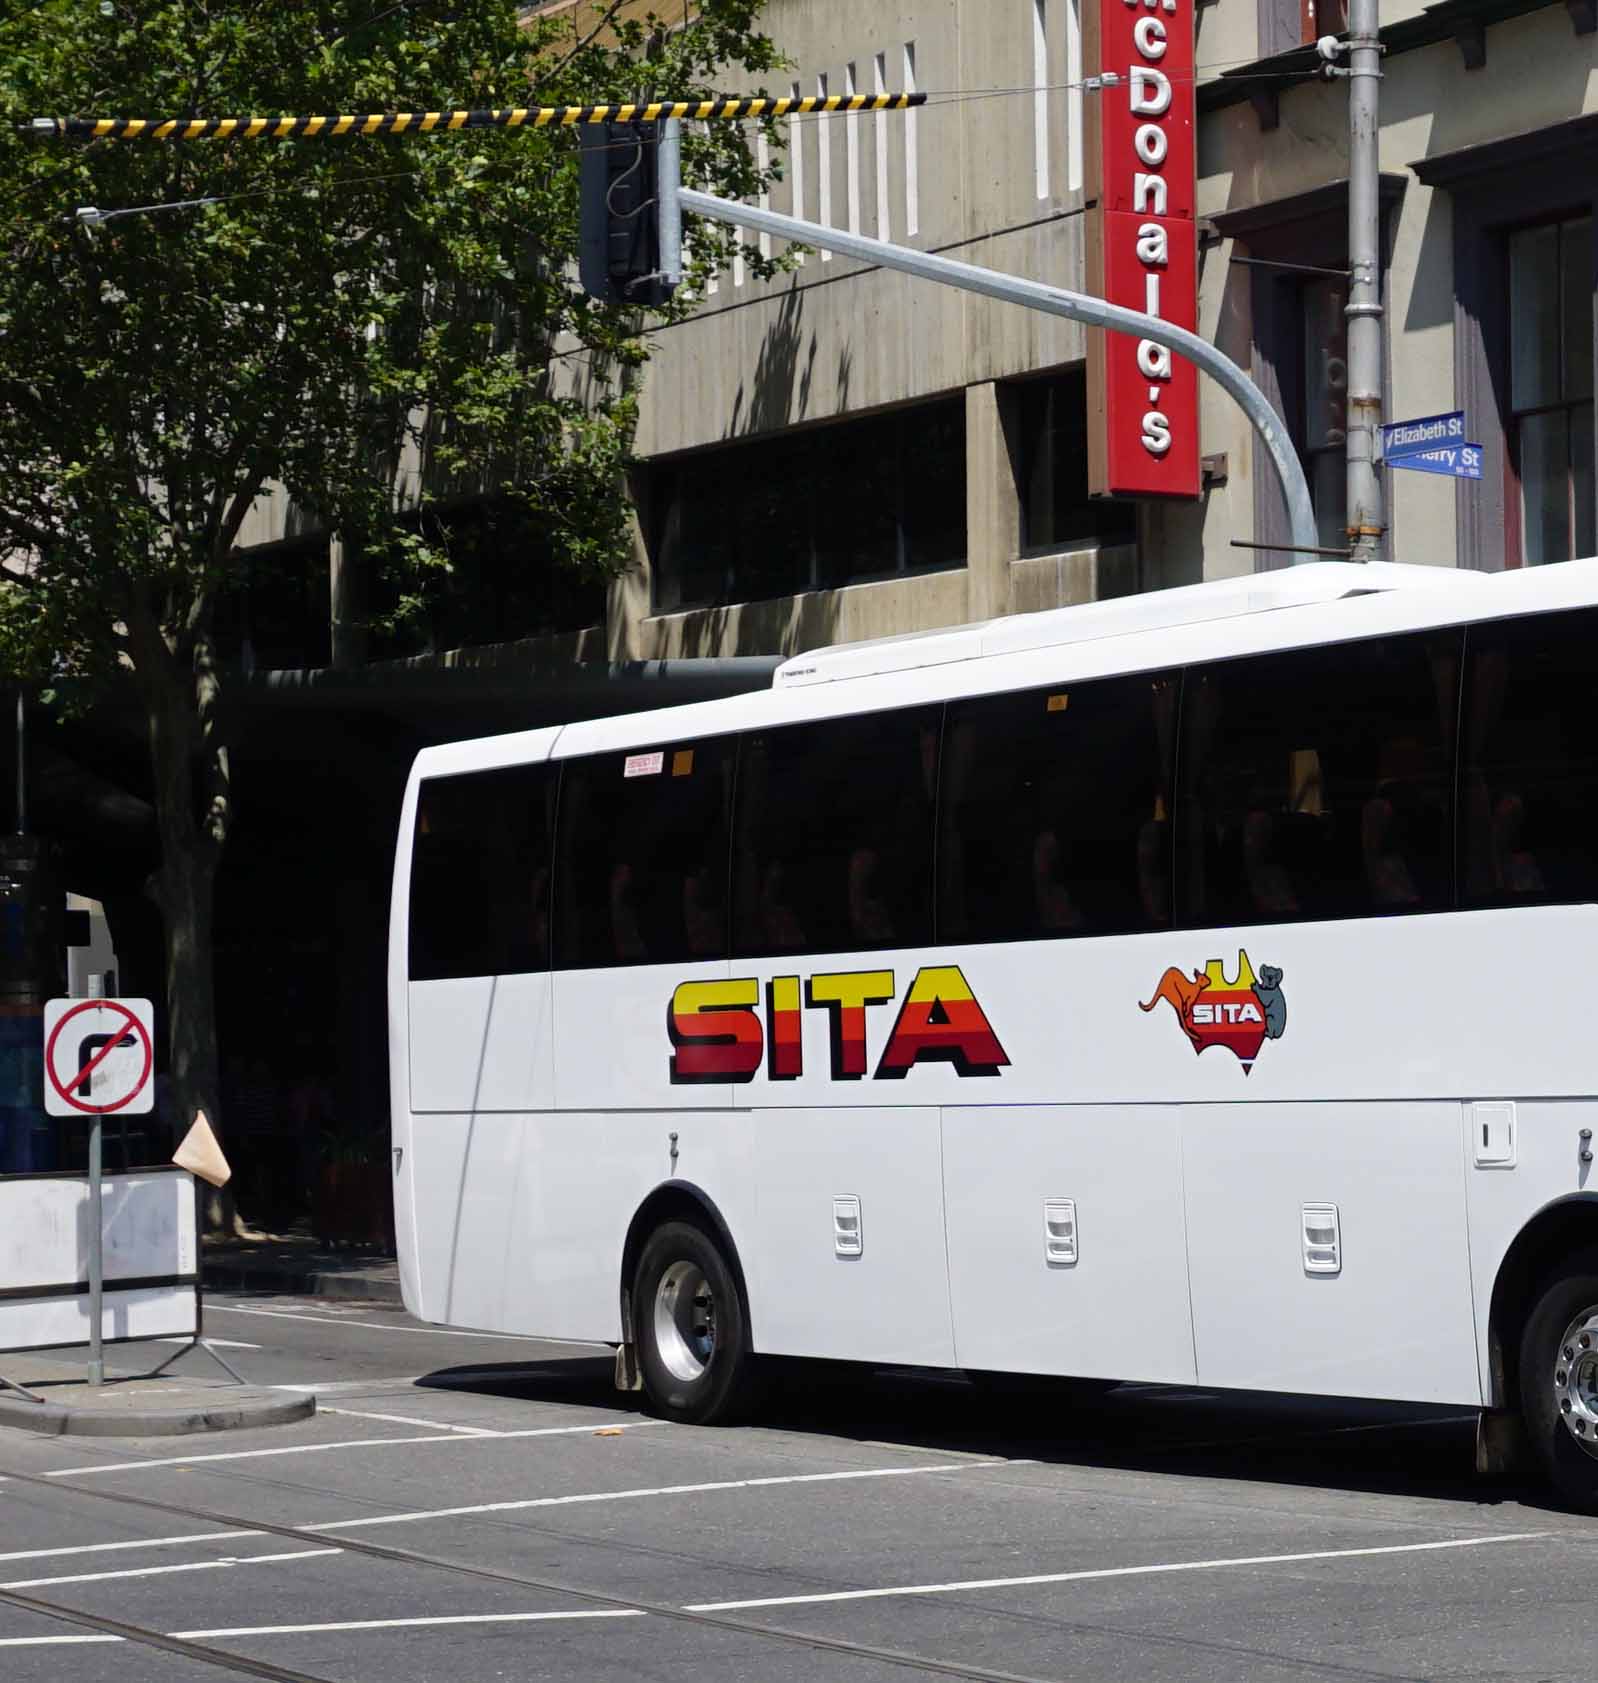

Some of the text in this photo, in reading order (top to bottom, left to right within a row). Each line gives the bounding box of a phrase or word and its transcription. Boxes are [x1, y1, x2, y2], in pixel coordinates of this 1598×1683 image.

[1122, 0, 1177, 453] cDonald's
[1394, 418, 1462, 446] Elizabeth St
[1462, 447, 1480, 467] St
[666, 964, 1012, 1085] SITA
[1192, 1003, 1263, 1024] SITA
